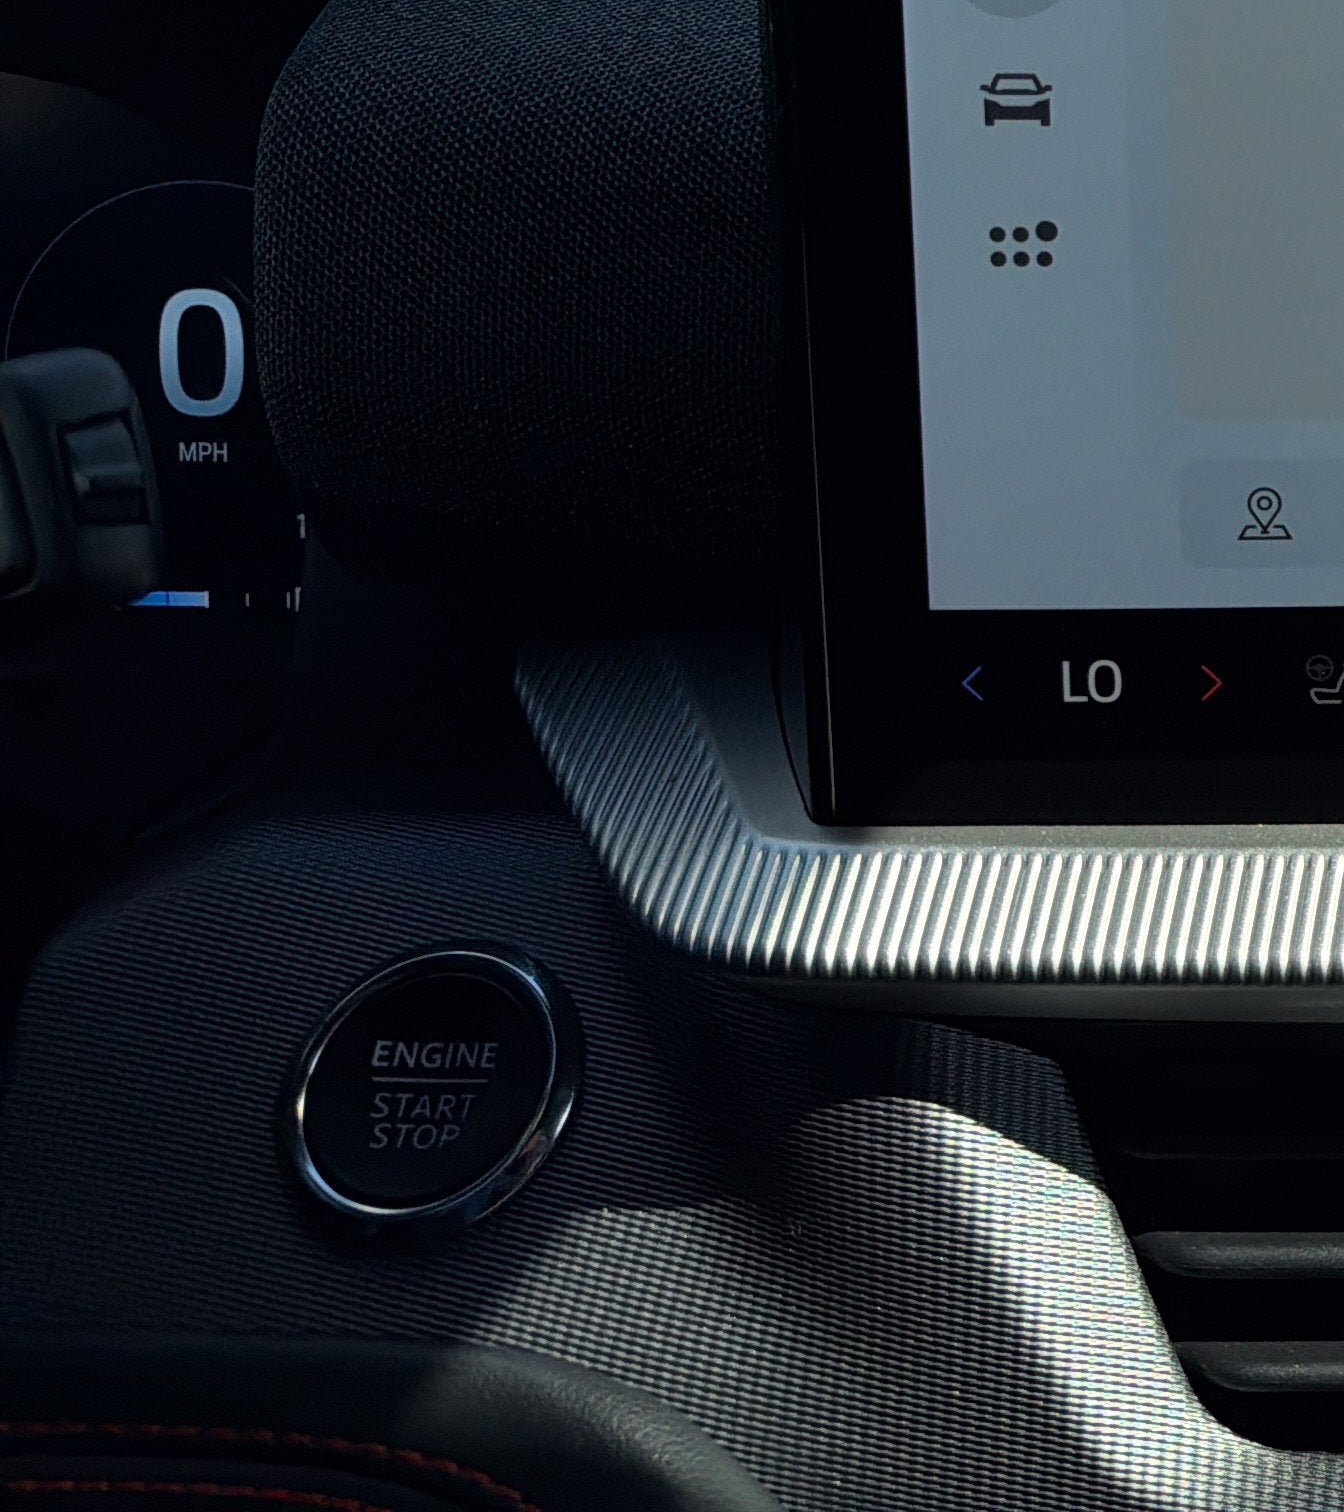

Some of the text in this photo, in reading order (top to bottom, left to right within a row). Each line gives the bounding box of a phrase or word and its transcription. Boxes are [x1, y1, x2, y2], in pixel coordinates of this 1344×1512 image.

[158, 288, 245, 417] 0
[178, 441, 229, 463] MPH
[1061, 659, 1123, 704] LO
[371, 1039, 500, 1069] ENGINE
[370, 1092, 477, 1119] START
[370, 1123, 461, 1150] STOP
